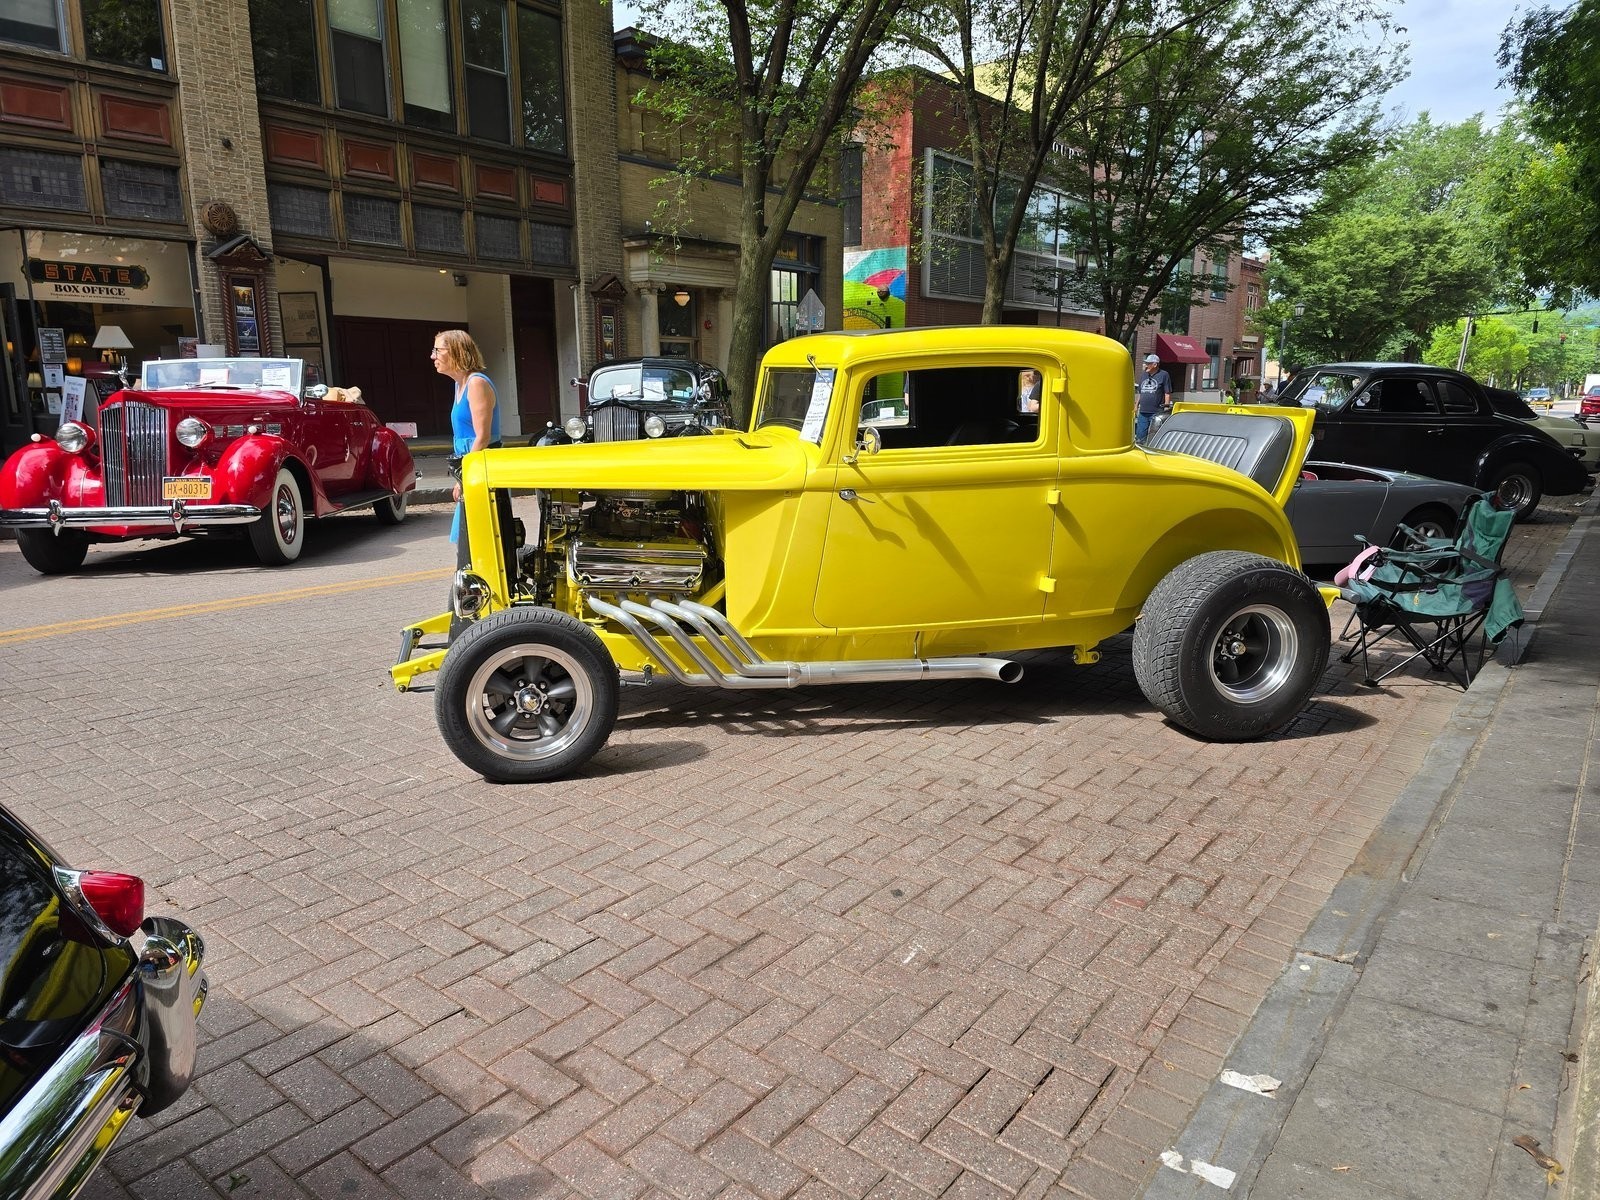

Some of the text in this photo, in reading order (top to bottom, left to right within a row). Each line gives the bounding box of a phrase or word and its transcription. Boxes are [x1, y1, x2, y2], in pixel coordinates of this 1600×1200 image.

[44, 263, 131, 284] STATE
[54, 284, 80, 293] BOX
[82, 285, 126, 297] OFFICE
